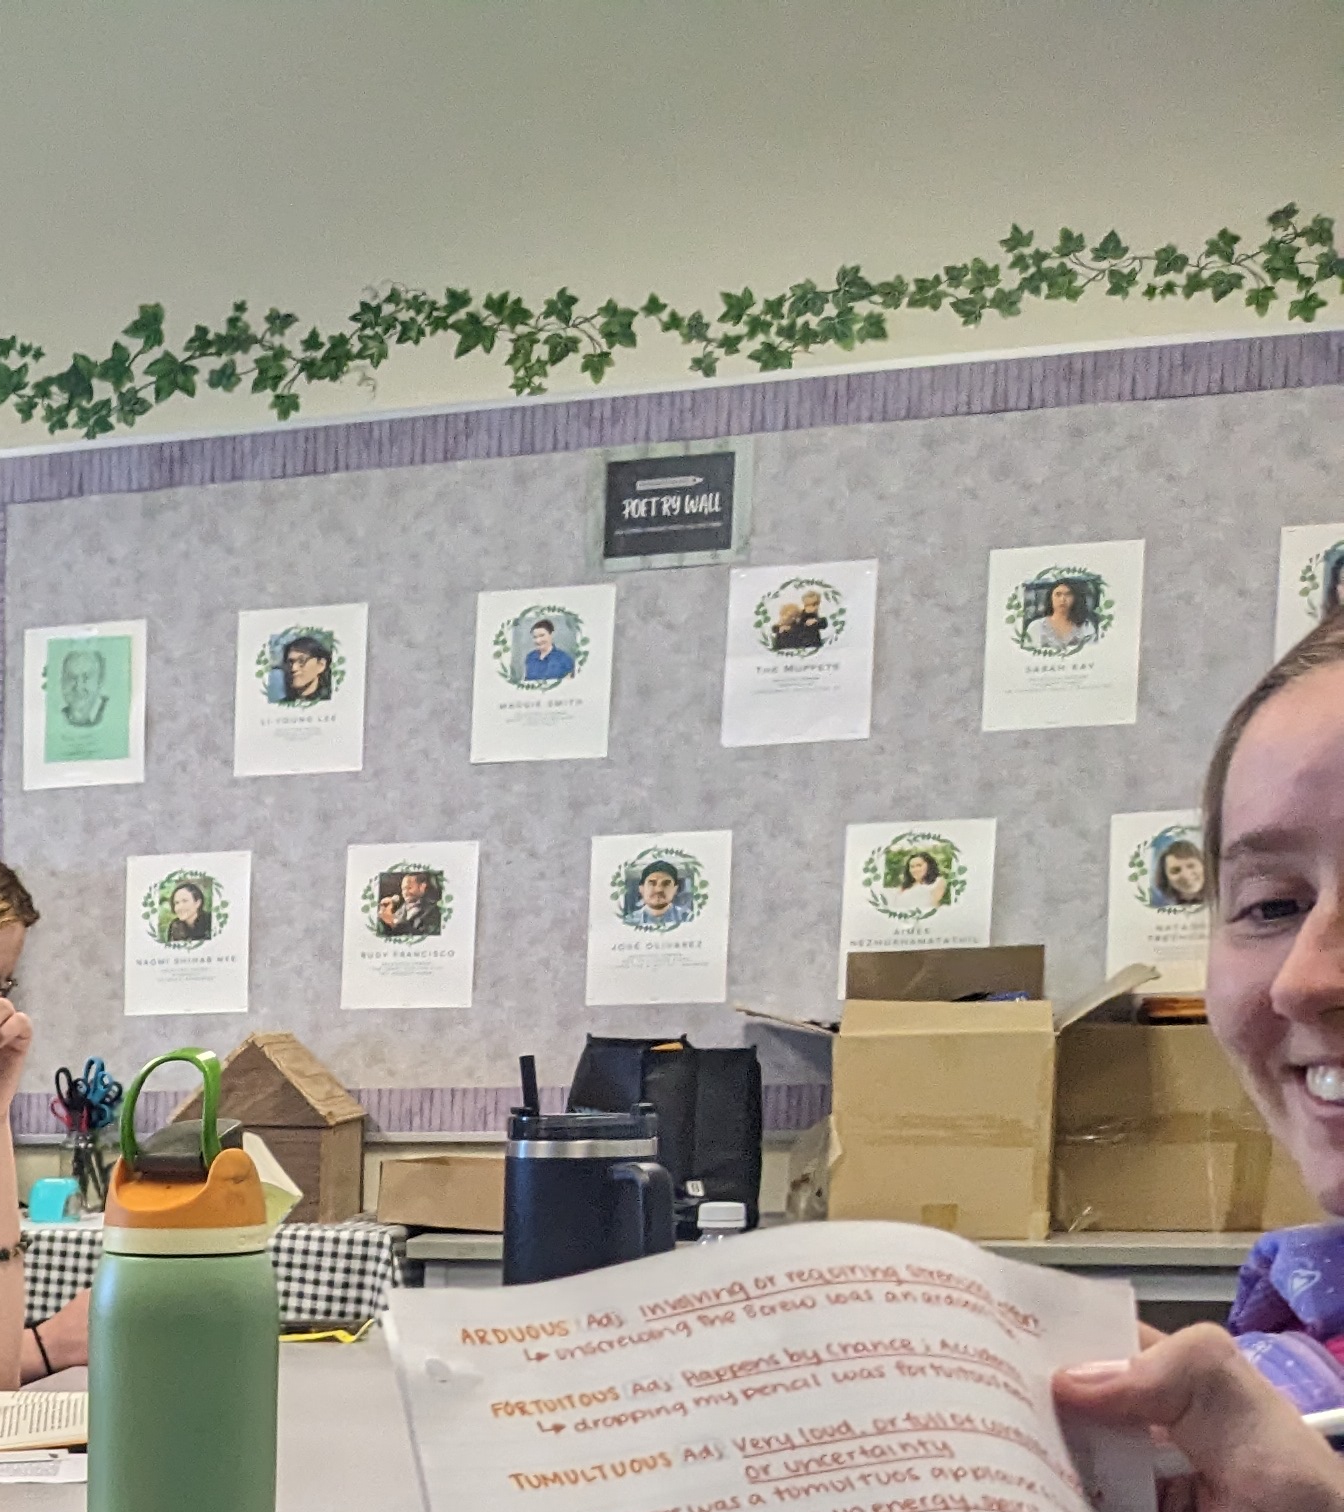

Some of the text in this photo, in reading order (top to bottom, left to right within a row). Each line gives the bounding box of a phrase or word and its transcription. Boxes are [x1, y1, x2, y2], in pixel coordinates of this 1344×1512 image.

[622, 492, 722, 519] POETRY WALL
[461, 1318, 570, 1346] ARDUOUS
[753, 1275, 775, 1291] or
[697, 1310, 736, 1328] the
[826, 1289, 873, 1305] was
[490, 1386, 620, 1419] FORTUITOUS
[783, 1347, 820, 1367] by
[573, 1363, 887, 1434] dropping my pencil was
[509, 1451, 672, 1491] TUMULTUOUS
[872, 1415, 897, 1433] or
[744, 1439, 955, 1479] or uncertainty
[747, 1492, 767, 1506] a
